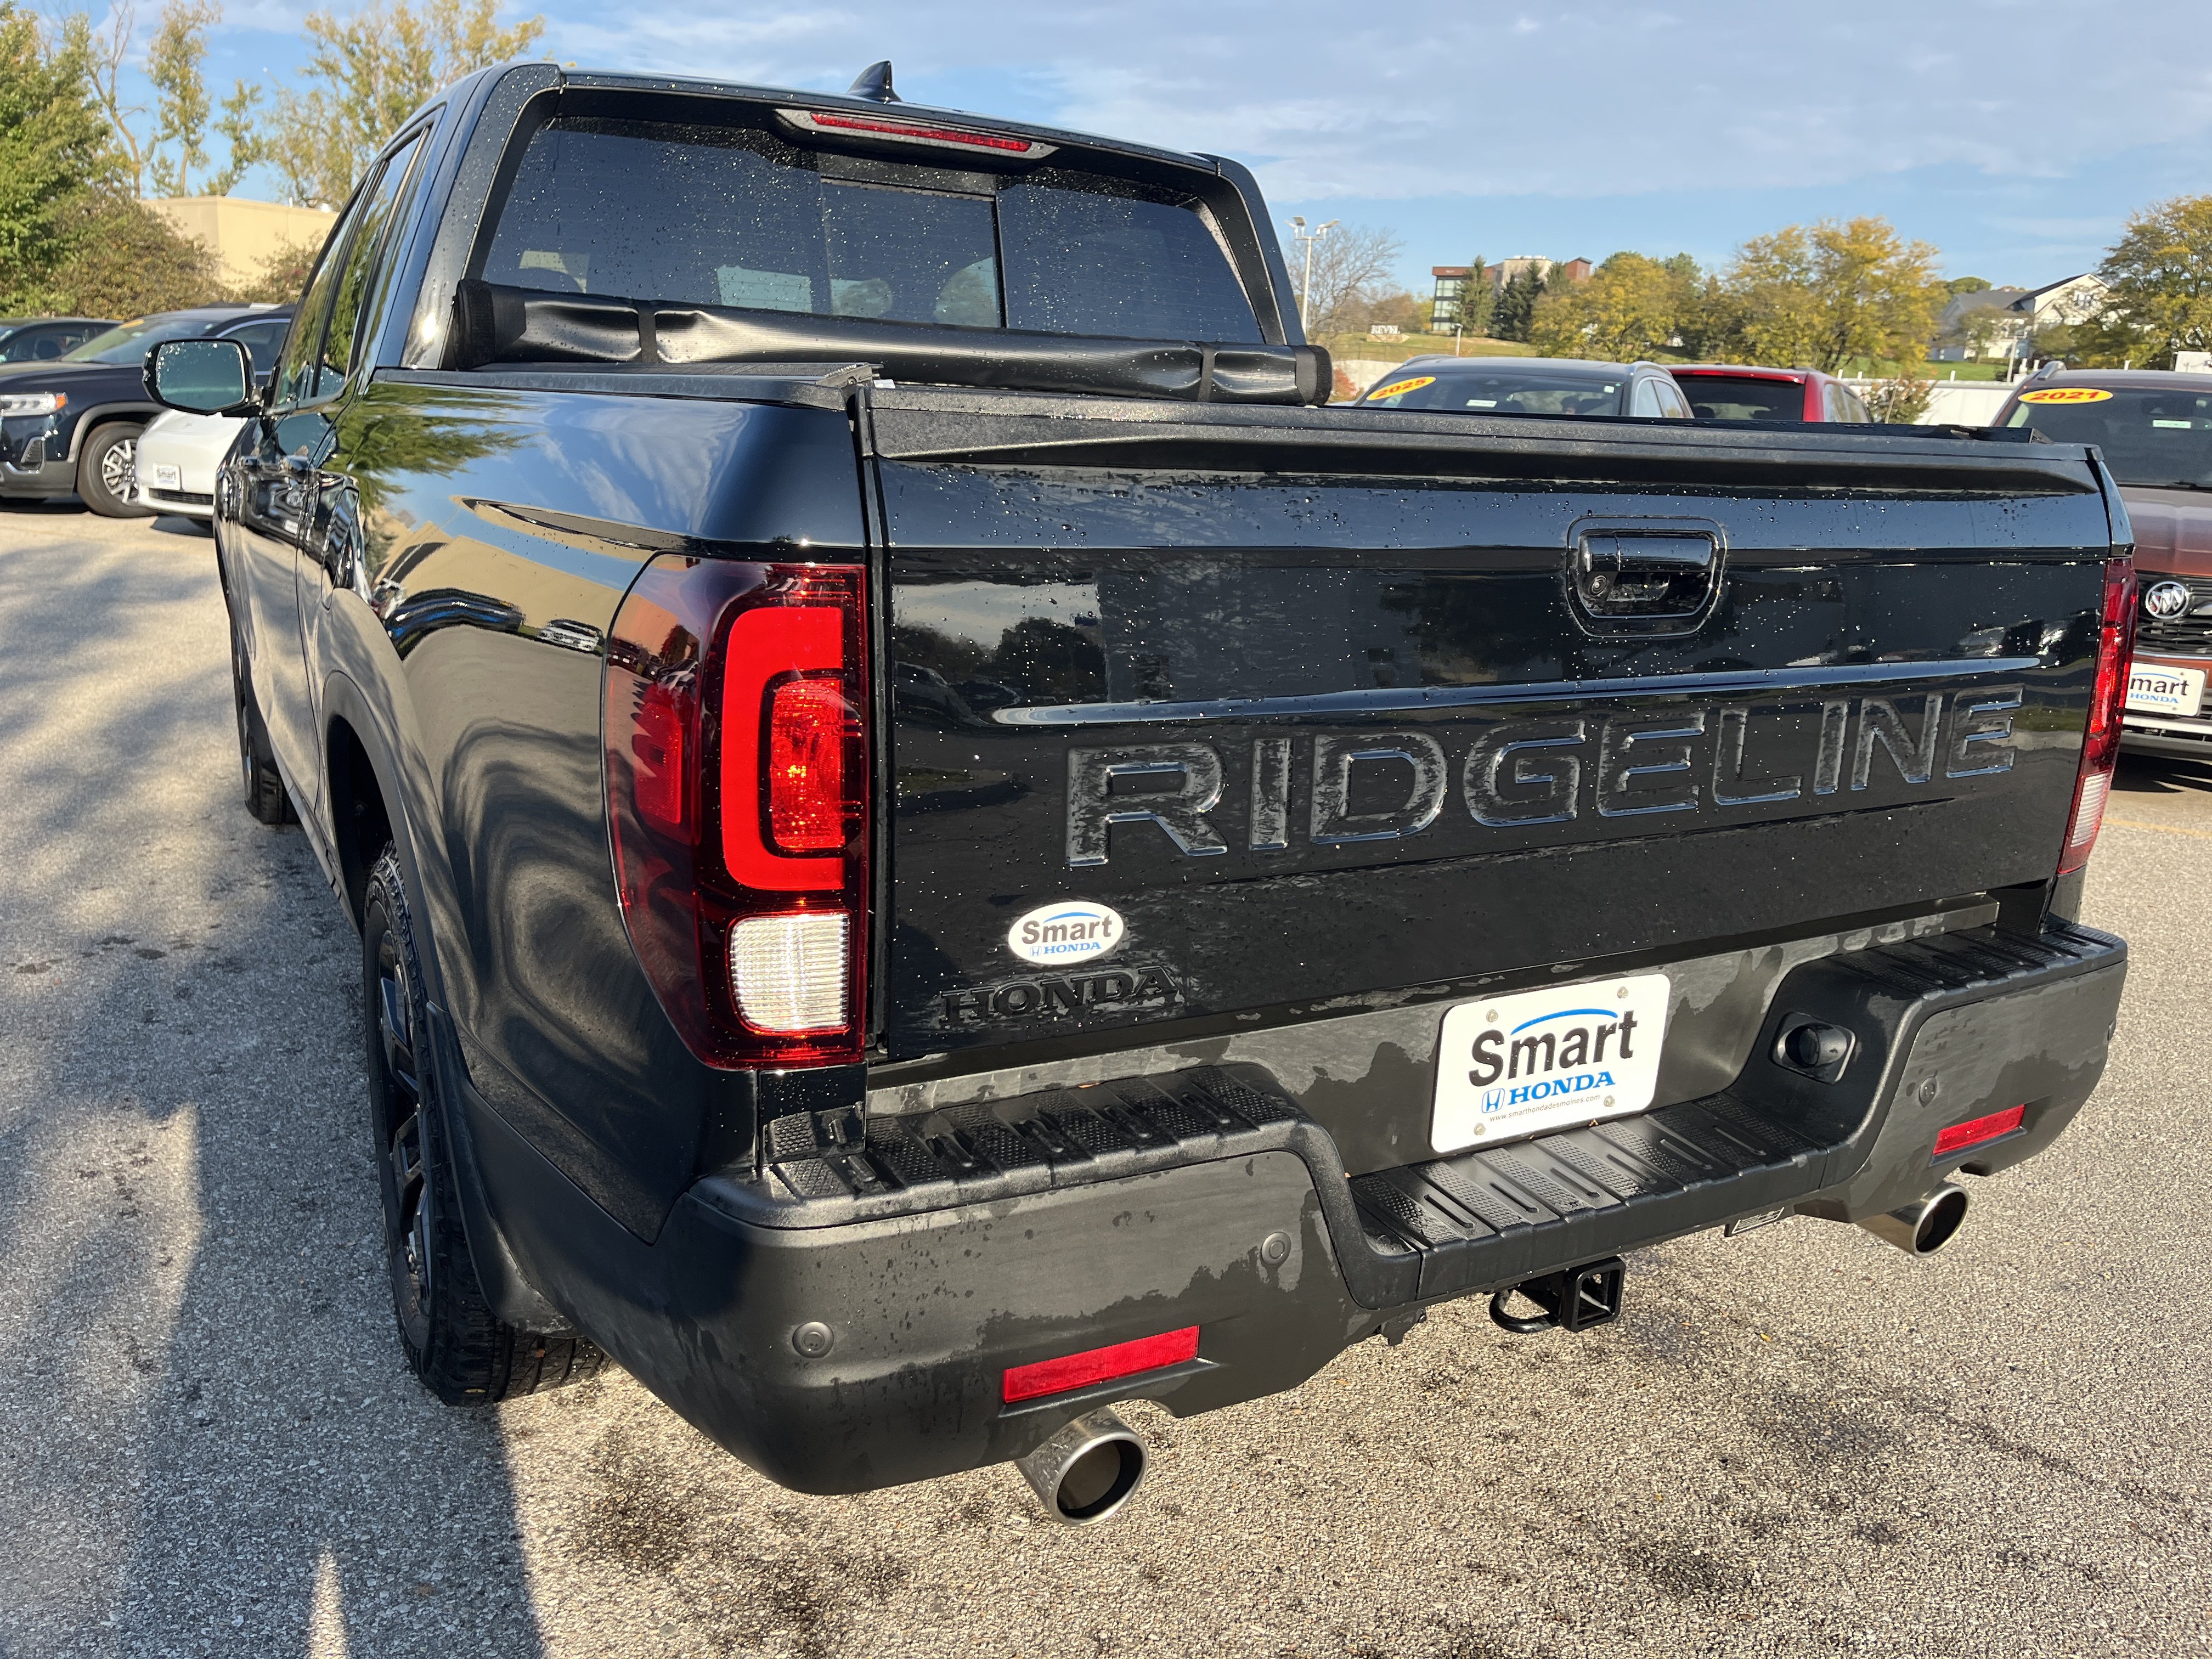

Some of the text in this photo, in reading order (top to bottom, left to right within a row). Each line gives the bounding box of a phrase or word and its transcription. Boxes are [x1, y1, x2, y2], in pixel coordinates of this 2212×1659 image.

[1376, 379, 1427, 398] 2025
[2030, 392, 2100, 400] 2021
[2130, 678, 2189, 696] mart
[2130, 693, 2179, 703] HONDA
[1065, 683, 2025, 868] RIDGELINE
[1022, 915, 1112, 944] Smart
[1043, 942, 1102, 955] HONDA
[938, 966, 1181, 1026] HONDA
[1469, 1010, 1638, 1087] Smart
[1507, 1071, 1616, 1106] HONDA
[1489, 1094, 1600, 1122] www.smarthondadesmoines.com
